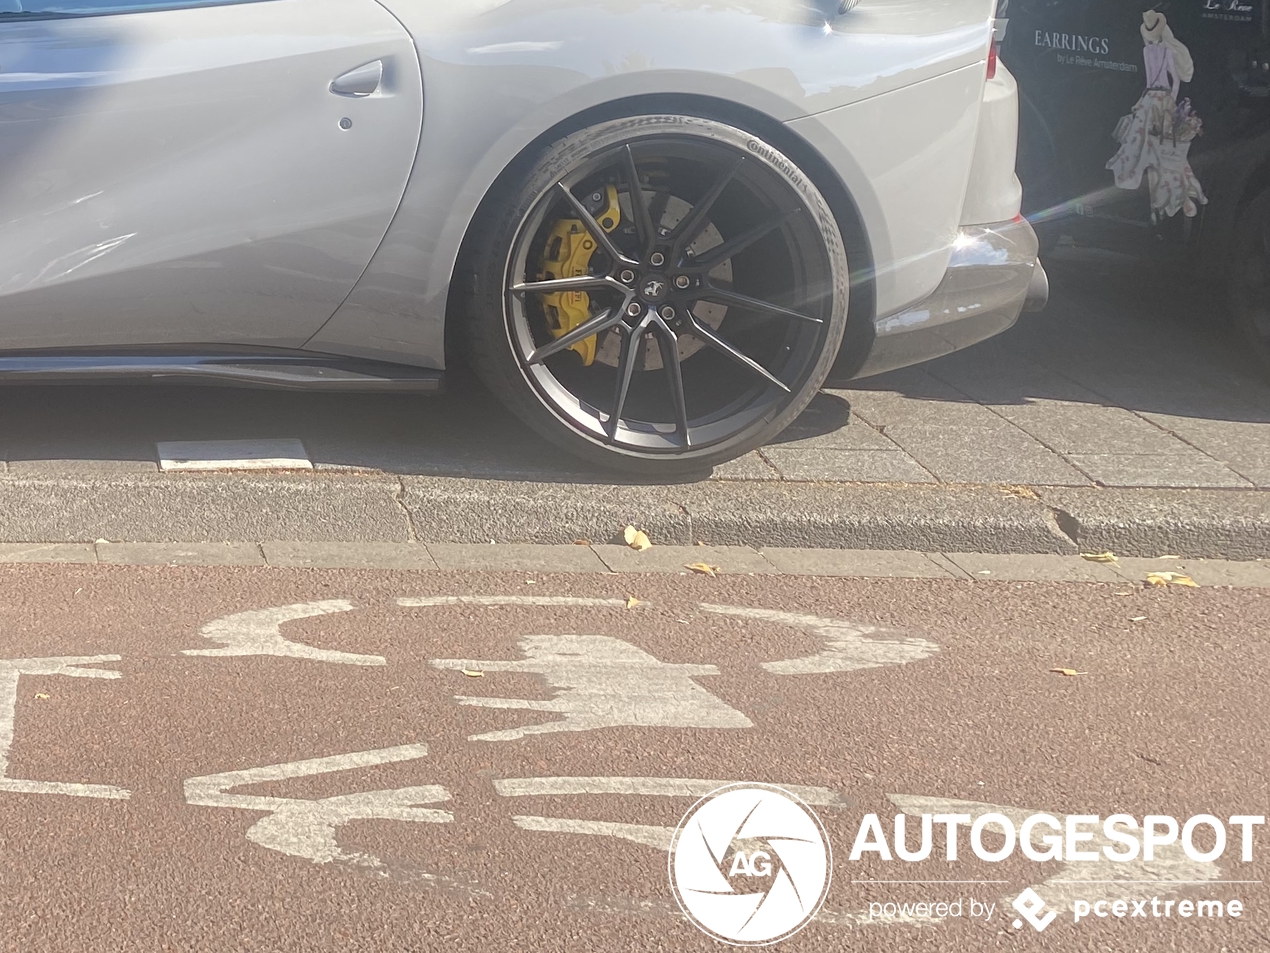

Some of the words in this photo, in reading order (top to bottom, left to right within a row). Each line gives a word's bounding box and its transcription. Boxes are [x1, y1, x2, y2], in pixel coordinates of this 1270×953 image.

[1034, 29, 1109, 55] EARRINGS
[1093, 57, 1138, 73] Amsterdam
[746, 139, 805, 187] Continental
